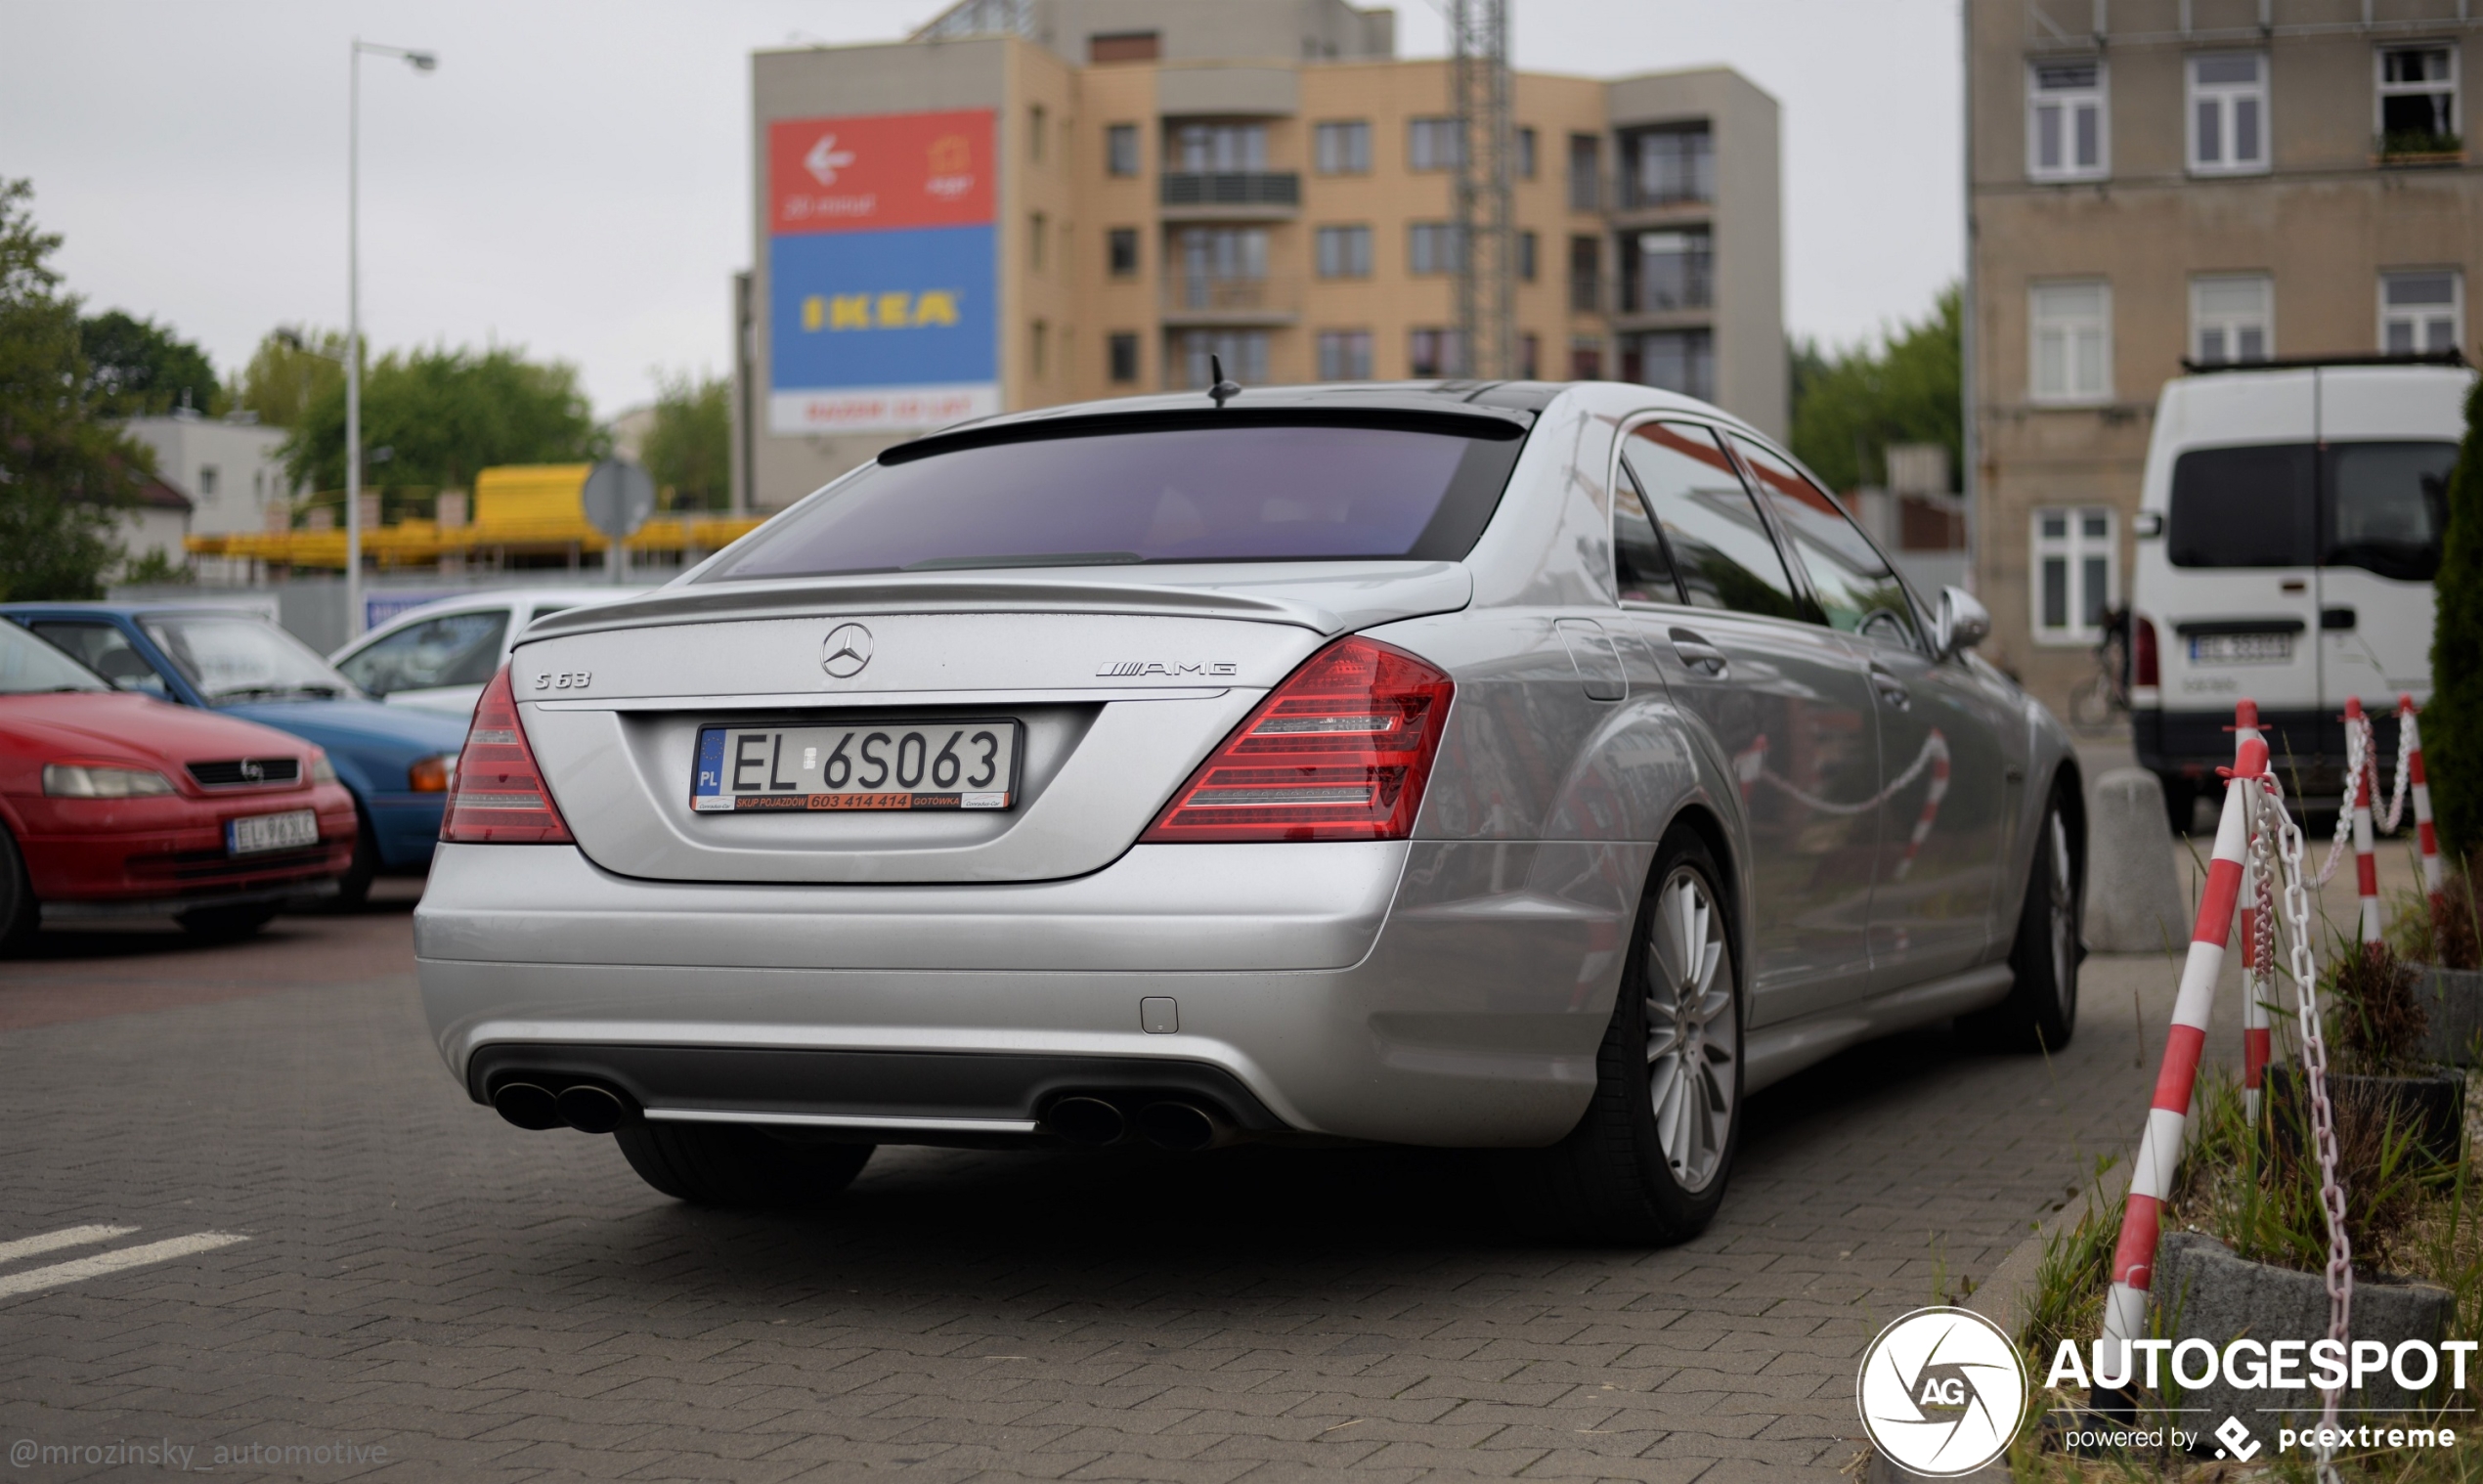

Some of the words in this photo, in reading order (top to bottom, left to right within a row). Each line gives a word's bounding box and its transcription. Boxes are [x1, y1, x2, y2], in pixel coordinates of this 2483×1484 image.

[802, 290, 960, 332] IKEA
[1139, 661, 1237, 676] AMG
[535, 672, 552, 690] S
[555, 672, 592, 689] 63
[732, 733, 797, 791] EL
[823, 730, 999, 789] 6S063
[700, 771, 718, 786] PL
[736, 798, 760, 807] SKUP
[760, 796, 807, 807] POJAZDÓW
[810, 795, 840, 807] 603
[844, 795, 874, 807] 414
[878, 795, 908, 807] 414
[913, 796, 960, 806] GOTÓWKA
